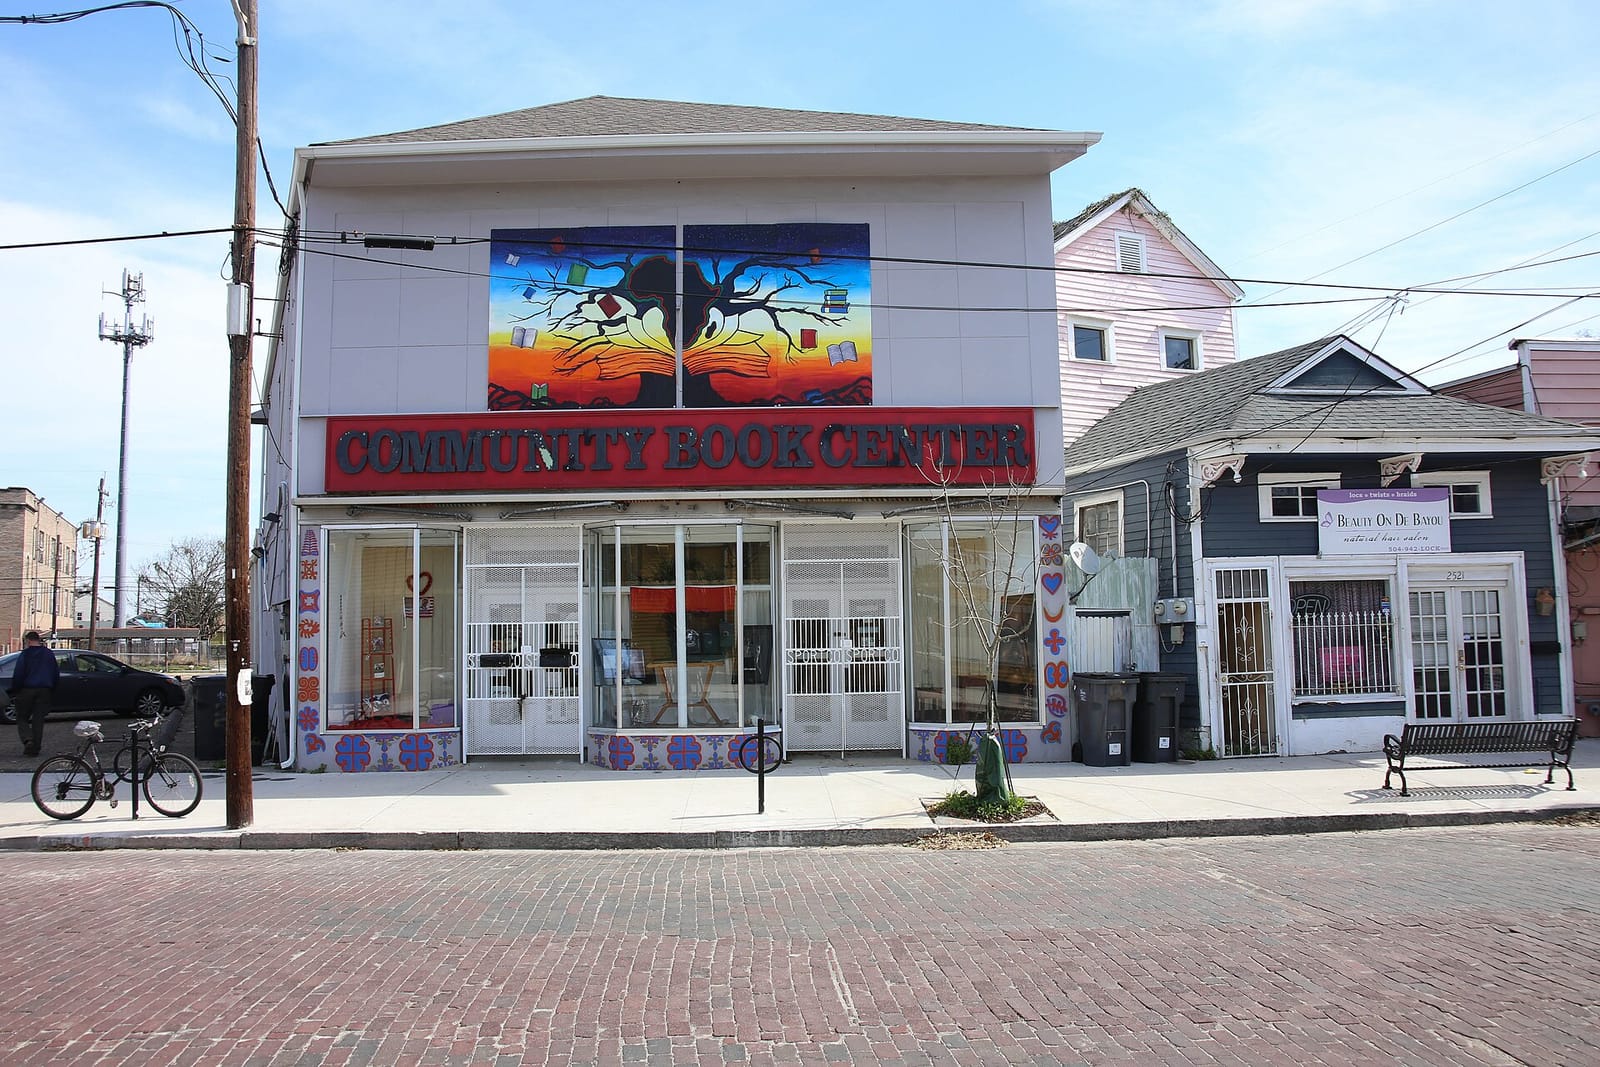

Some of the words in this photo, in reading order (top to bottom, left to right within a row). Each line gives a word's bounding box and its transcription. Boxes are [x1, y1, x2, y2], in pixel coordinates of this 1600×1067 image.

[334, 427, 656, 474] COMMUNITY
[663, 424, 814, 470] BOOK
[819, 423, 1031, 468] CENTER
[1337, 513, 1372, 527] BEAUTY
[1376, 513, 1392, 527] ON
[1413, 512, 1443, 526] BAYOU
[1343, 532, 1380, 542] natural
[1381, 532, 1399, 541] hair
[1403, 531, 1429, 541] salon
[1446, 570, 1465, 580] 2521
